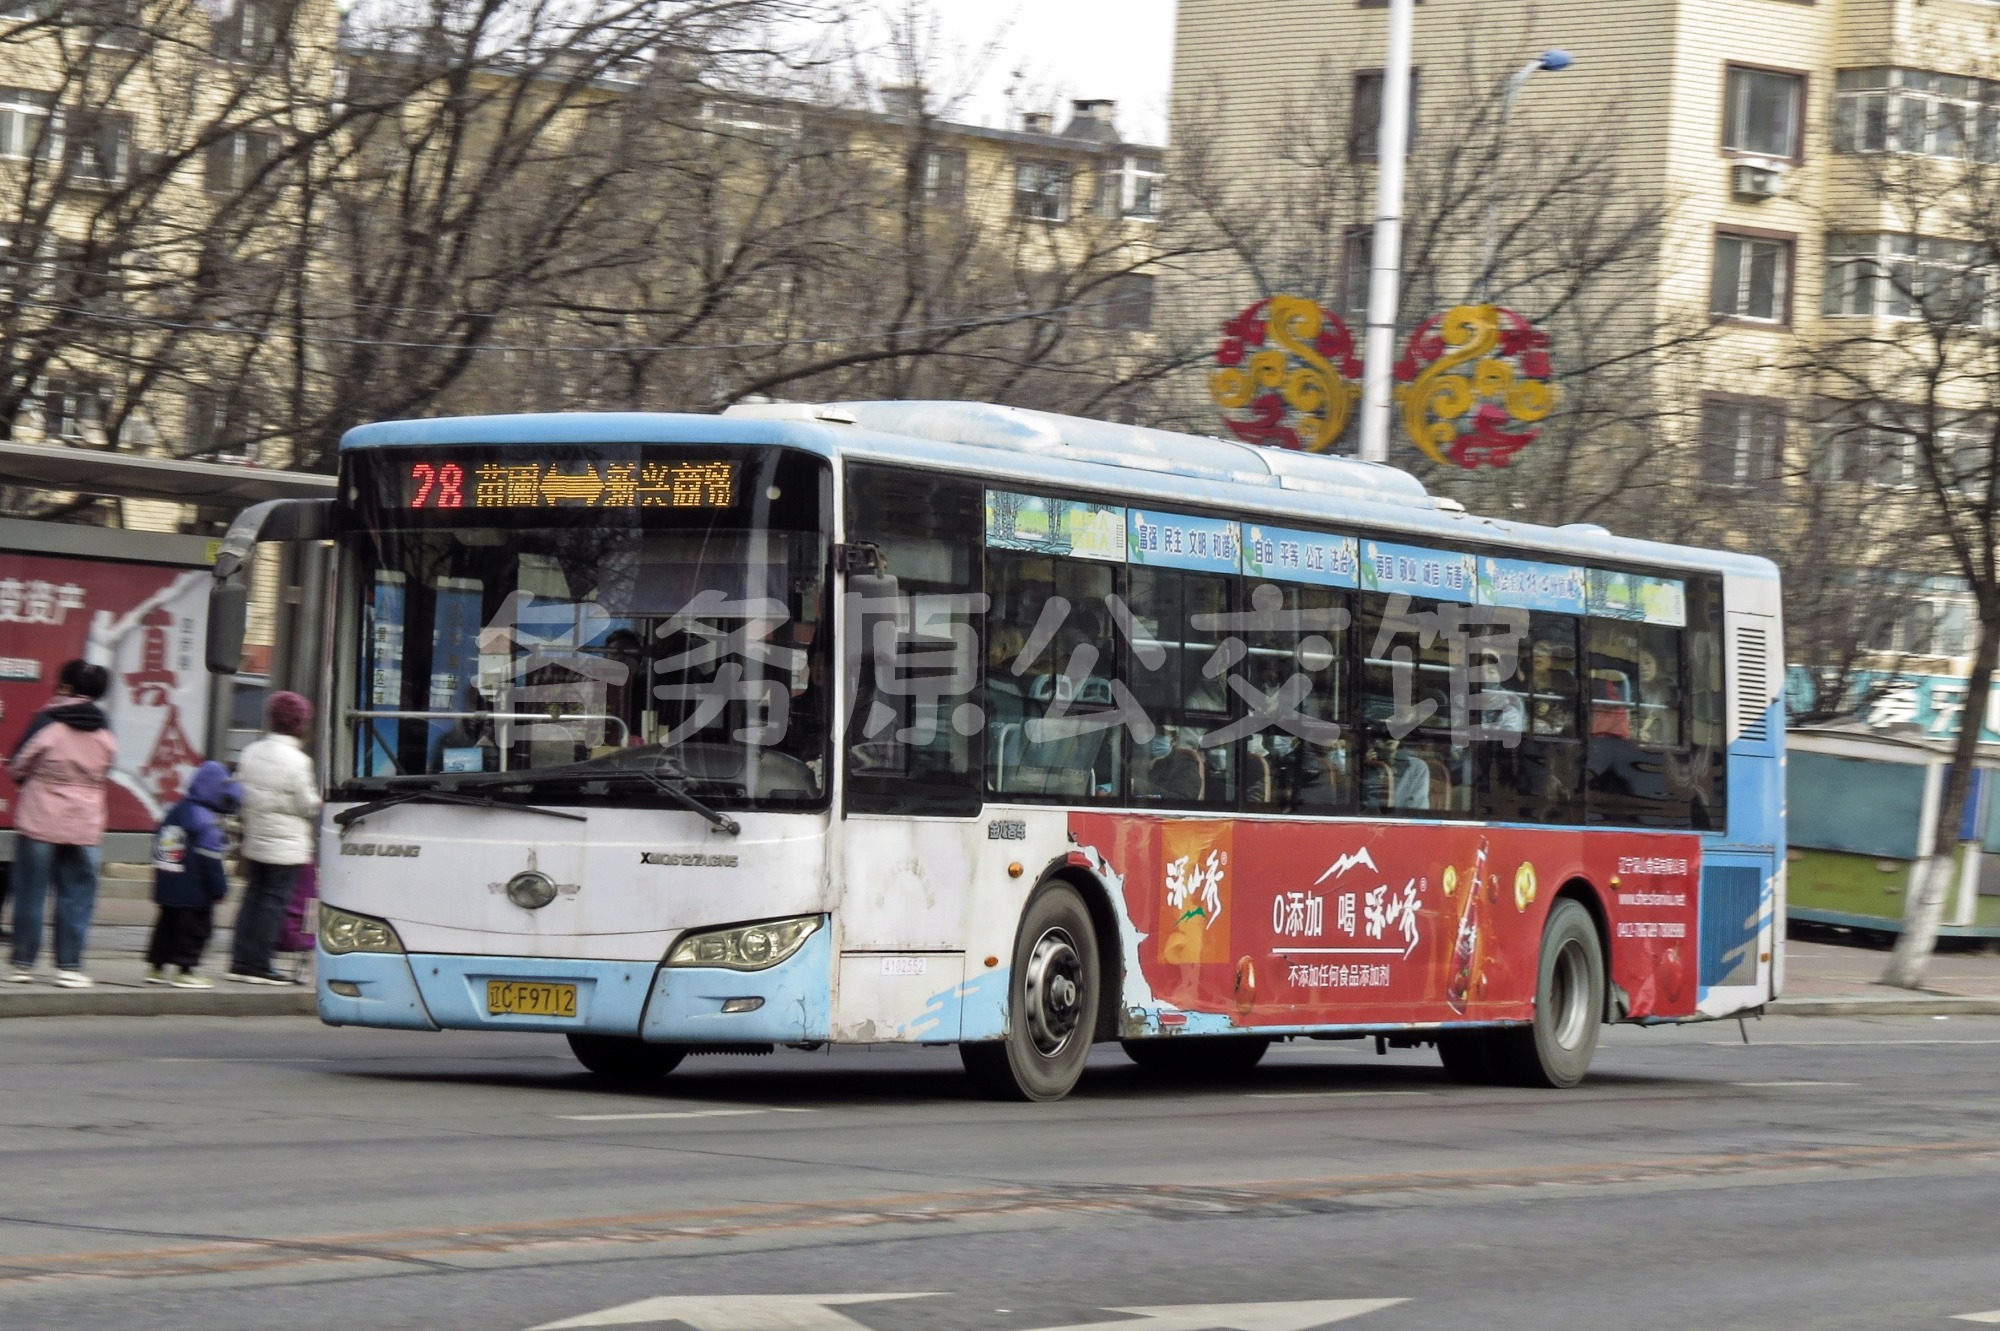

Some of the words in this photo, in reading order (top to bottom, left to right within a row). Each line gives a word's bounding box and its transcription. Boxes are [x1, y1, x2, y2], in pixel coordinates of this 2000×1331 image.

[411, 462, 464, 507] 28
[475, 463, 541, 507] 苗圃
[1139, 524, 1158, 551] 富强
[1165, 527, 1182, 554] 民主
[1189, 530, 1207, 556] 文明
[1213, 533, 1231, 558] 和谐
[1255, 539, 1273, 564] 自由
[1280, 541, 1299, 568] 平等
[1306, 545, 1324, 570] 公正
[1330, 547, 1348, 573] 法治
[1376, 554, 1393, 580] 爱国
[1399, 557, 1417, 582] 敬业
[1423, 560, 1440, 586] 诚信
[1446, 563, 1463, 589] 友善
[988, 819, 1026, 840] 金龙客车
[340, 843, 376, 856] KING
[377, 844, 421, 858] LONG
[1272, 890, 1323, 938] 0添加
[1337, 893, 1356, 938] 喝
[884, 959, 925, 974] 4102552
[1287, 964, 1391, 988] 不添加任何食品添加剂
